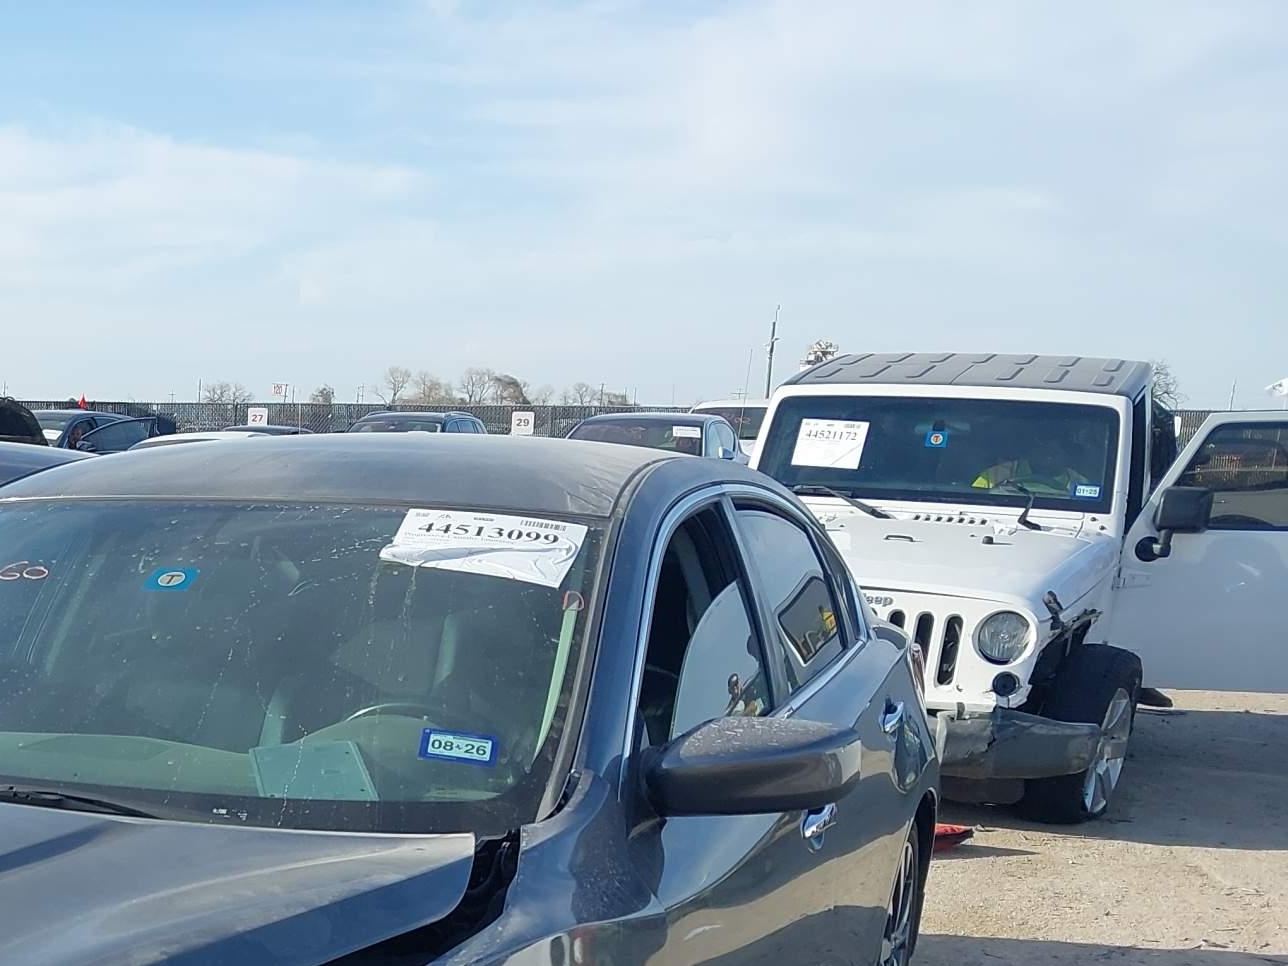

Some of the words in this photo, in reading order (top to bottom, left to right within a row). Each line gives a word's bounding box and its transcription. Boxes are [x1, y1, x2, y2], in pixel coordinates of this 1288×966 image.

[251, 414, 264, 423] 27
[516, 418, 530, 427] 29
[417, 522, 560, 545] 44513099
